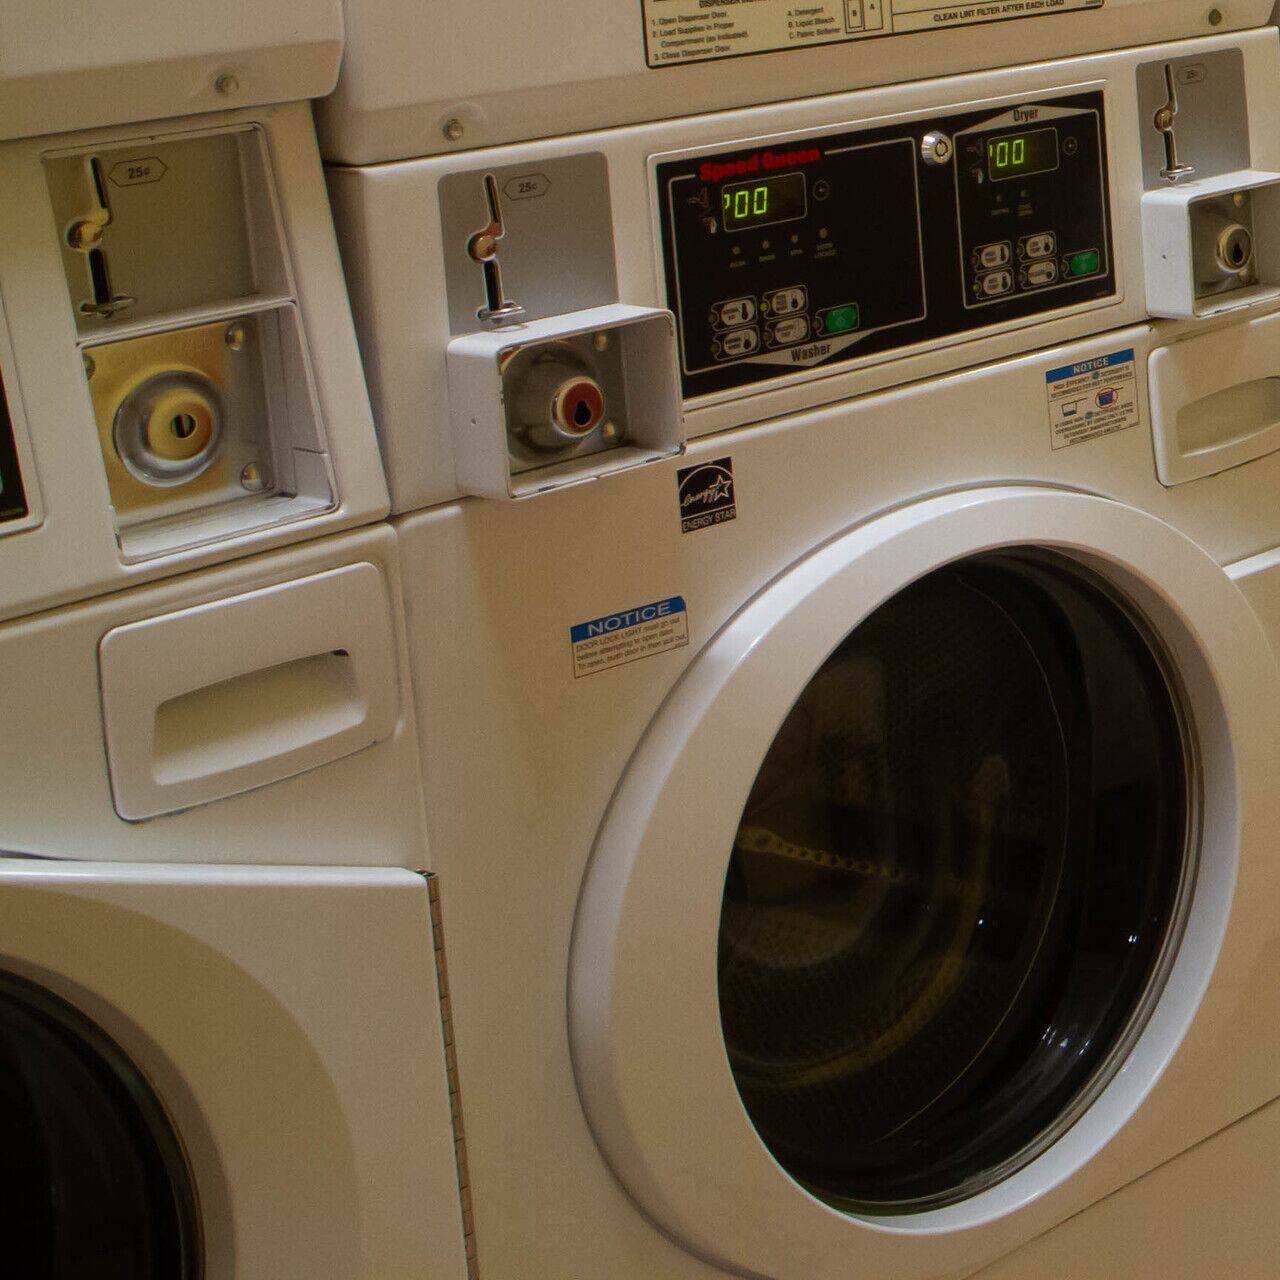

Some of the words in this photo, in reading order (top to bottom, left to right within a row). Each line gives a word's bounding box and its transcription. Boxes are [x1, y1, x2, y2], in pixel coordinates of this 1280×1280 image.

[933, 10, 958, 23] CLEAN
[959, 8, 974, 19] LINT
[976, 5, 1000, 17] FILTER
[1001, 2, 1023, 14] AFTER
[1025, 0, 1044, 11] EACH
[1013, 108, 1039, 122] Dryer
[699, 155, 759, 184] Speed
[762, 149, 821, 173] Queen
[791, 343, 832, 363] Washer
[1073, 357, 1109, 374] NOTICE
[682, 514, 714, 531] ENERGY
[715, 508, 736, 523] STAR
[588, 601, 671, 637] NOTICE
[576, 639, 597, 652] DOOR
[599, 633, 618, 645] LOCK
[620, 627, 641, 639] LIGHT
